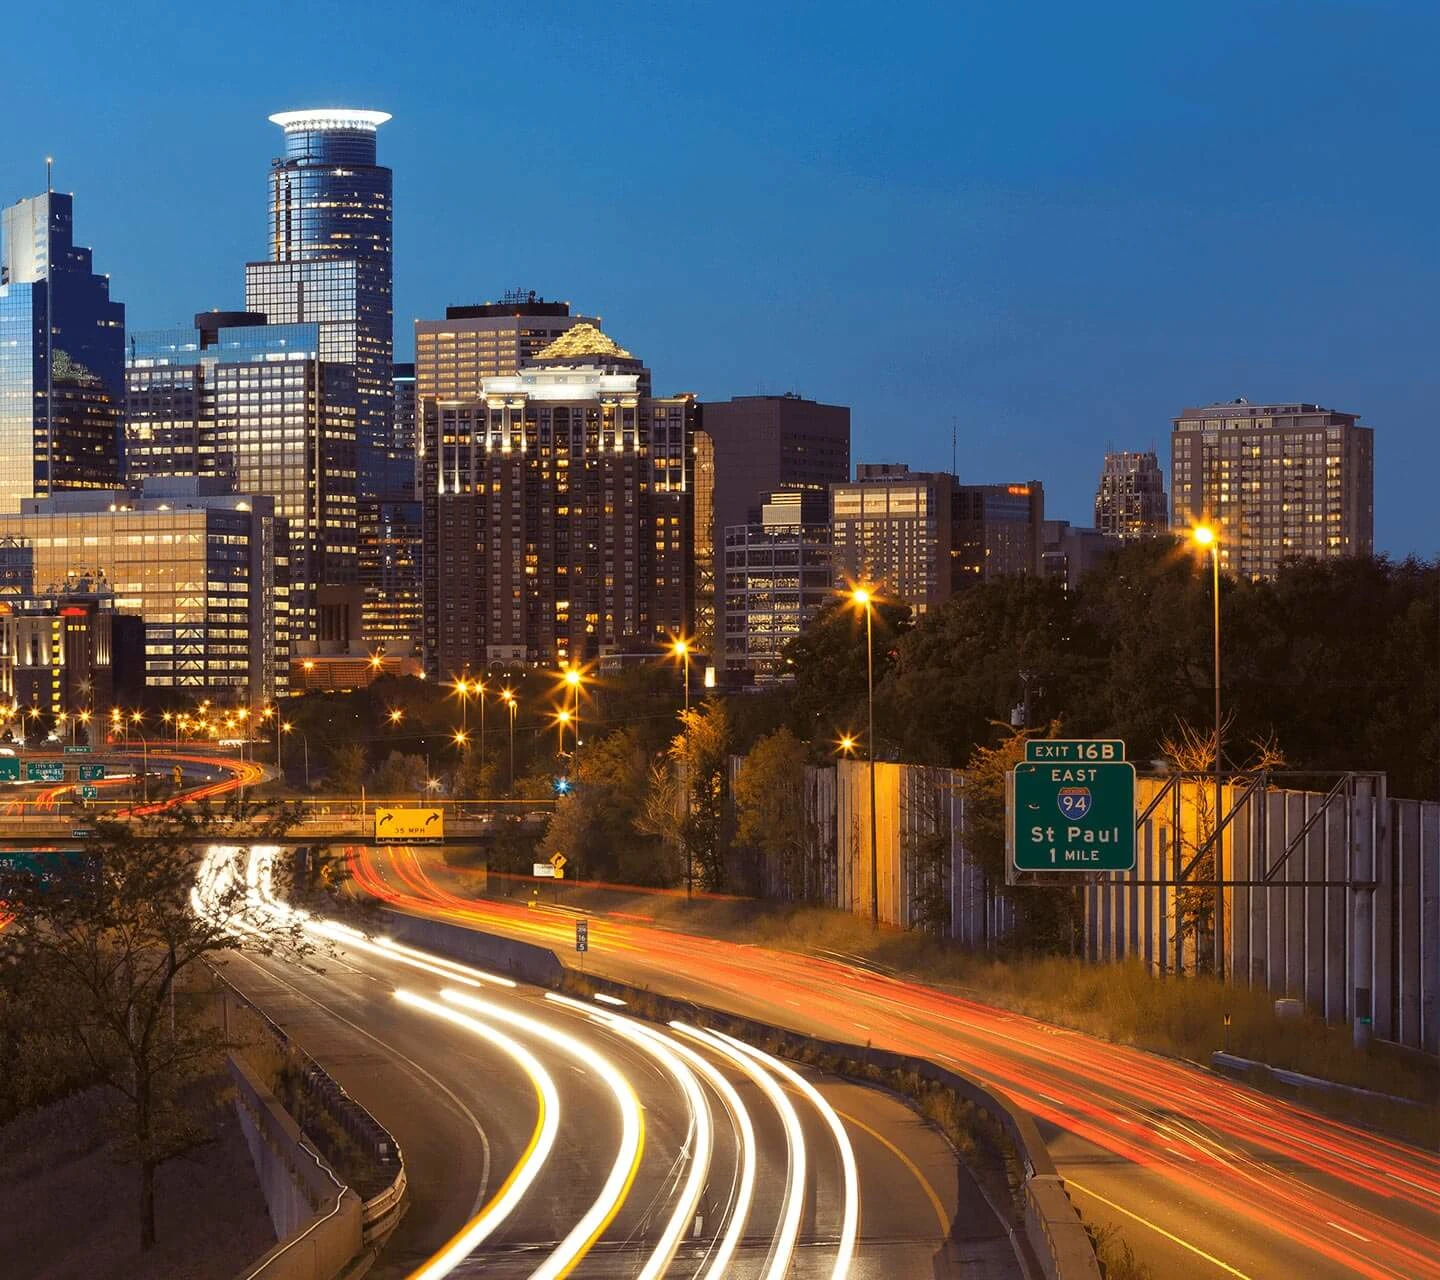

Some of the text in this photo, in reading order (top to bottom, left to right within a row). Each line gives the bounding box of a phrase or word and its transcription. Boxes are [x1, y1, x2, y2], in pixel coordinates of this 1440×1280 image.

[1035, 744, 1115, 759] EXIT 16B
[1051, 769, 1098, 782] EAST
[1063, 796, 1086, 812] 94
[1032, 826, 1119, 842] St Paul
[1050, 848, 1100, 863] 1 MILE
